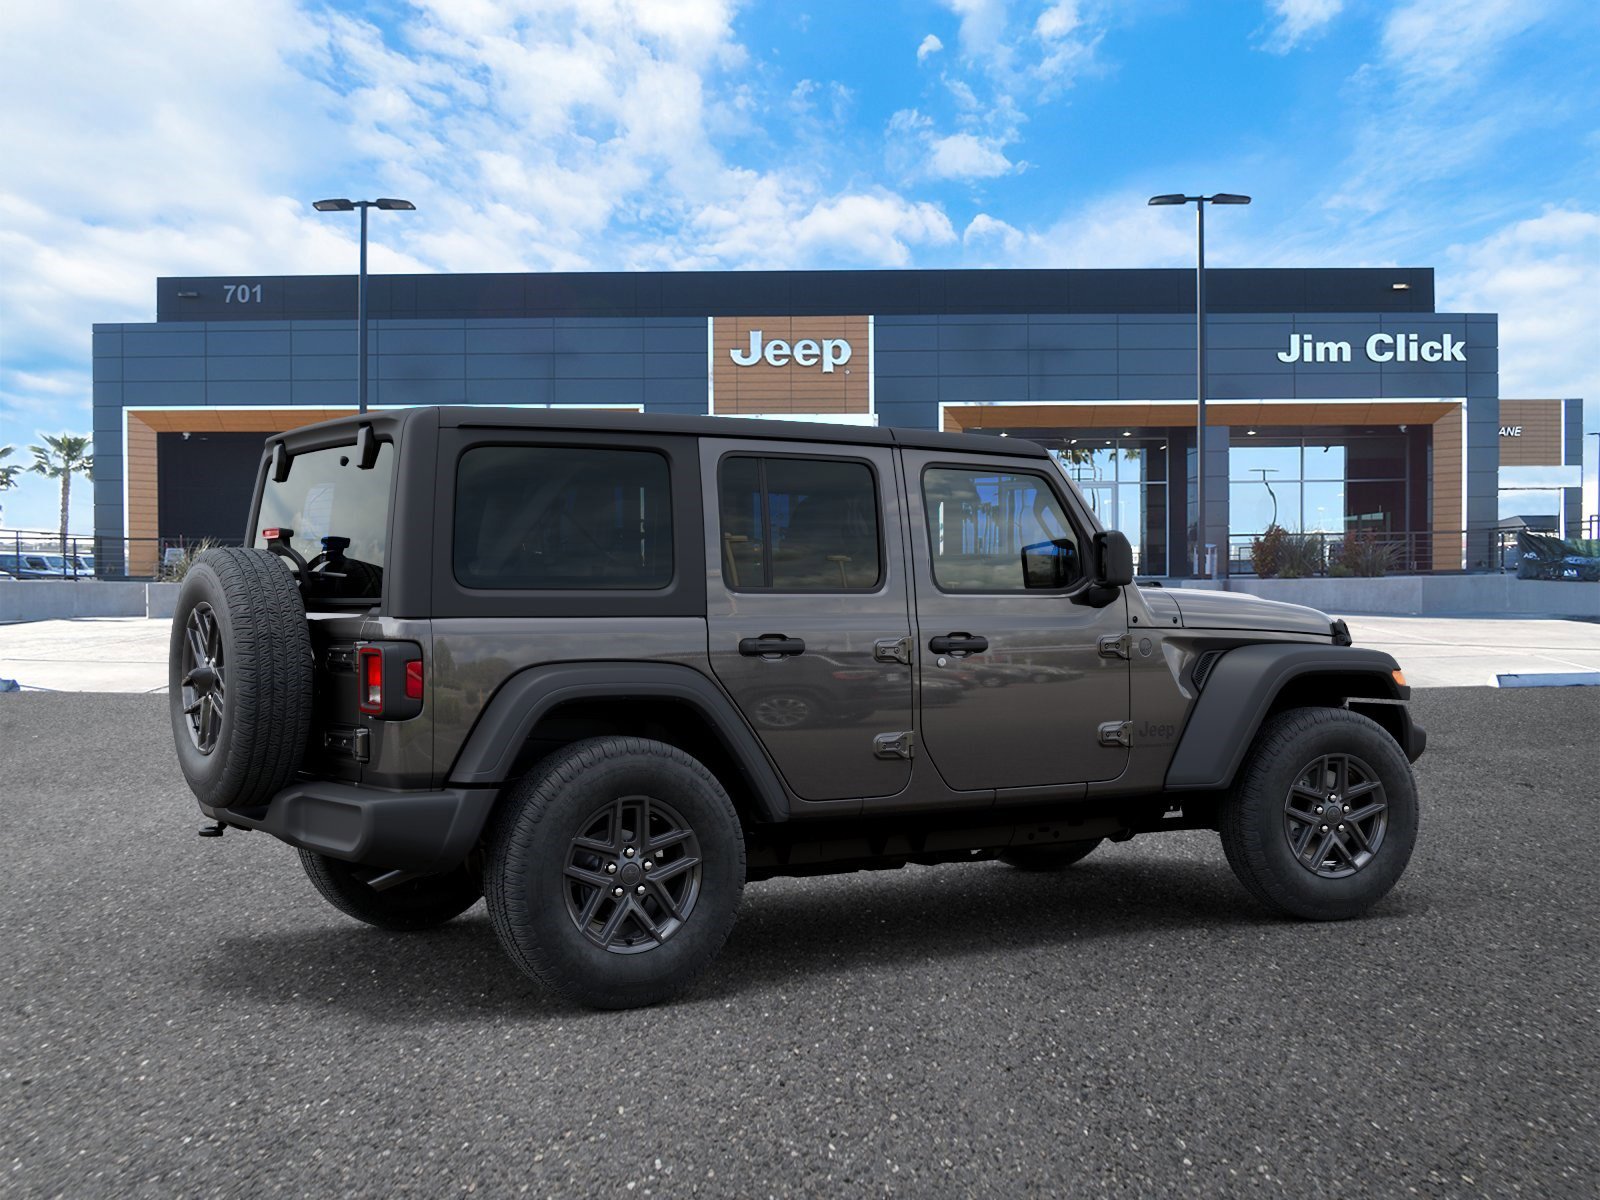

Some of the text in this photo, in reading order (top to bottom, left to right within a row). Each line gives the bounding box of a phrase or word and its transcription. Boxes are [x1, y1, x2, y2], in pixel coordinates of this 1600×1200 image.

[223, 284, 262, 304] 701
[729, 330, 852, 374] Jeep
[1277, 333, 1467, 363] Jim Click
[1138, 721, 1176, 739] Jeep
